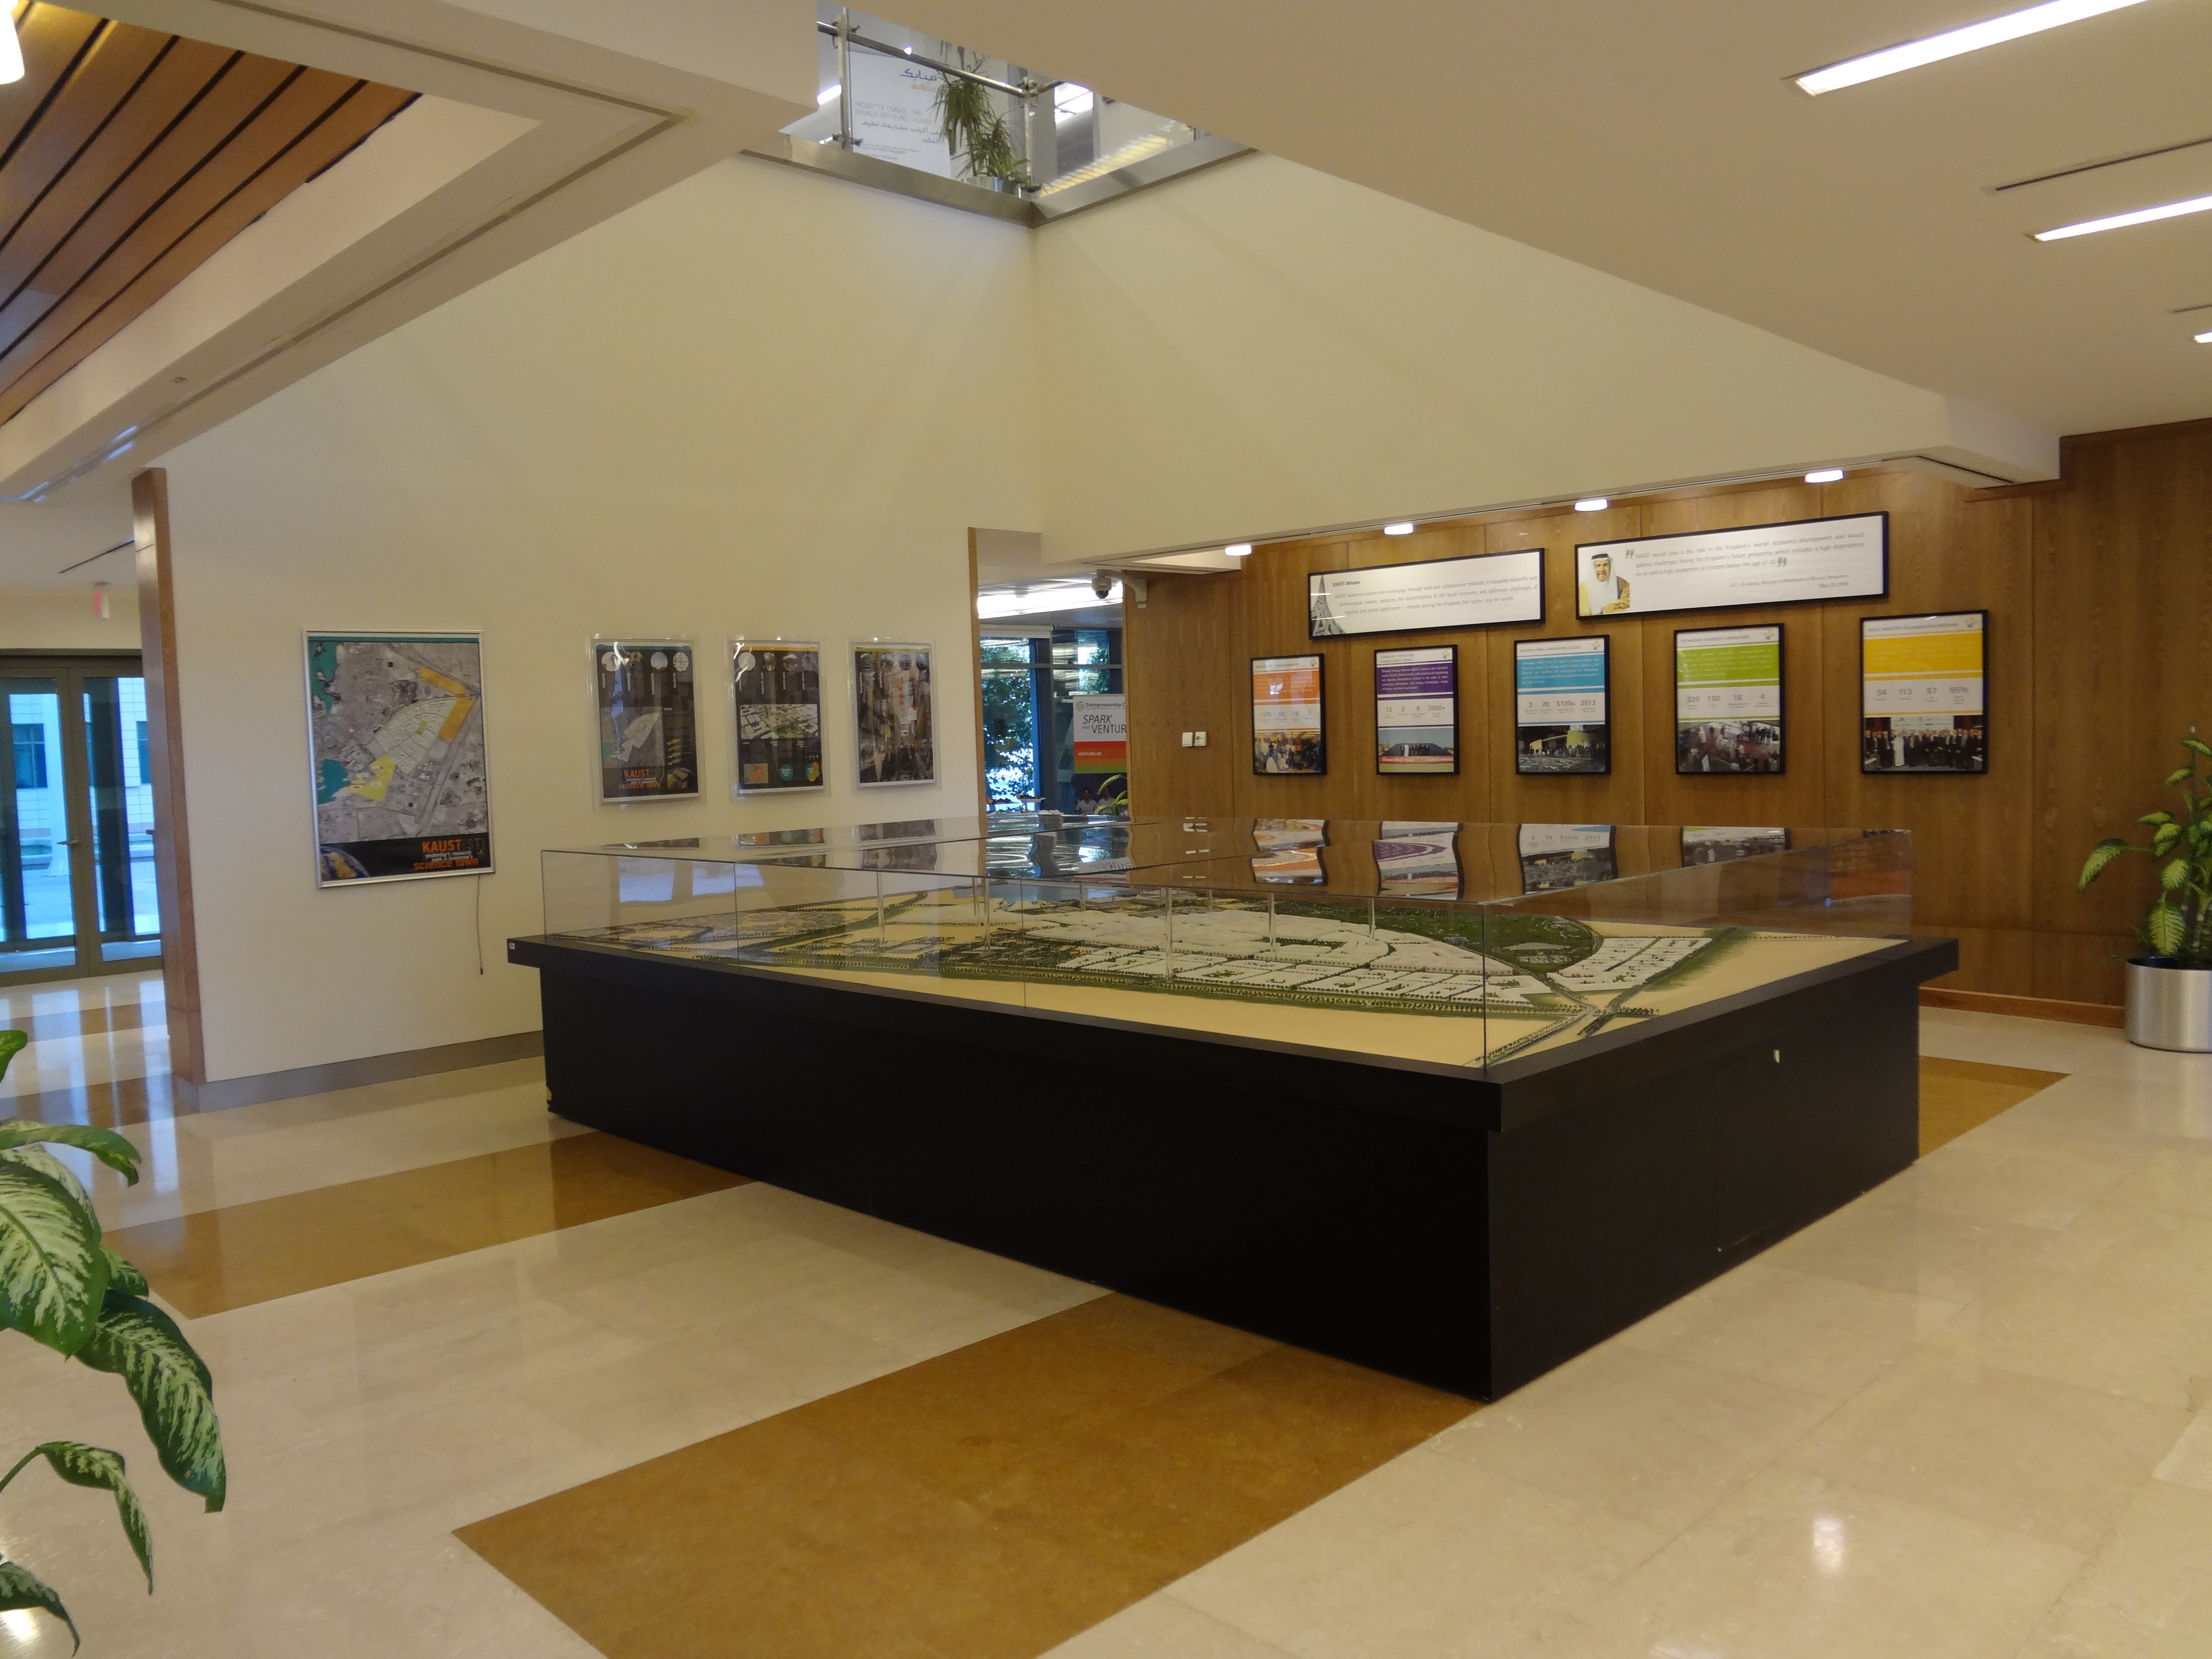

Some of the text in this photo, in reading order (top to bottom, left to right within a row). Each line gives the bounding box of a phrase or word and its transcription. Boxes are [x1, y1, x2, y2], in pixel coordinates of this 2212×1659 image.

[1082, 714, 1113, 724] SPARK
[1091, 724, 1126, 734] VENTUR
[624, 769, 649, 778] KAUST
[422, 839, 463, 854] KAUST
